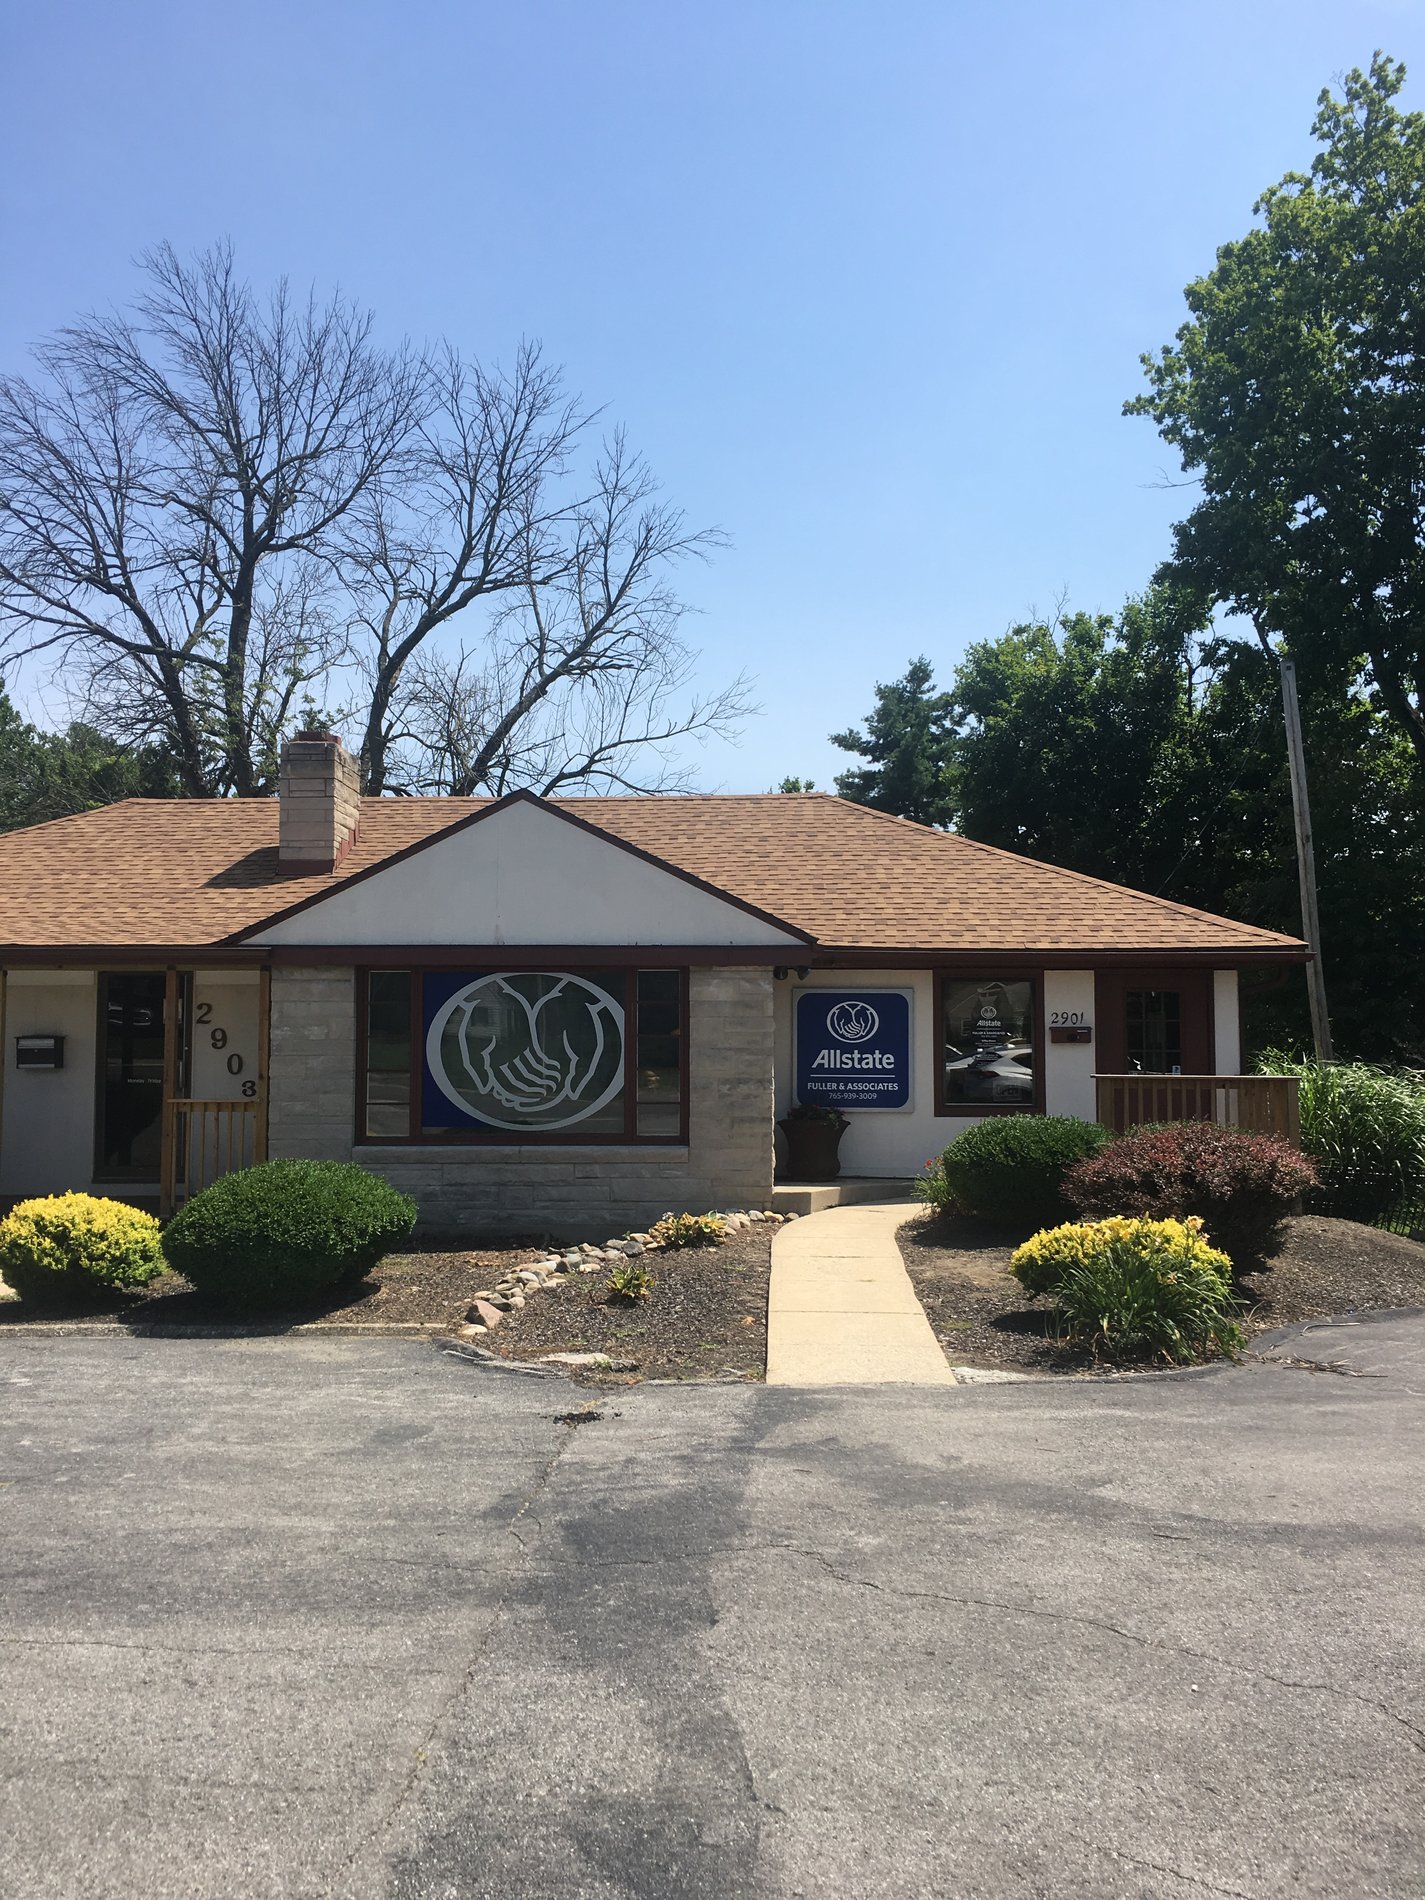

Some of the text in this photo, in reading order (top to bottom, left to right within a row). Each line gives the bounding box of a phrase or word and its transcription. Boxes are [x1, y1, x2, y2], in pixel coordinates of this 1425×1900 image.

[976, 1019, 1002, 1027] Allstate
[1051, 1011, 1084, 1026] 2901
[196, 1002, 257, 1098] 2903
[811, 1049, 895, 1069] Allstate
[808, 1082, 899, 1091] FULLER & ASSOCIATES
[828, 1092, 878, 1100] 765-939-3009
